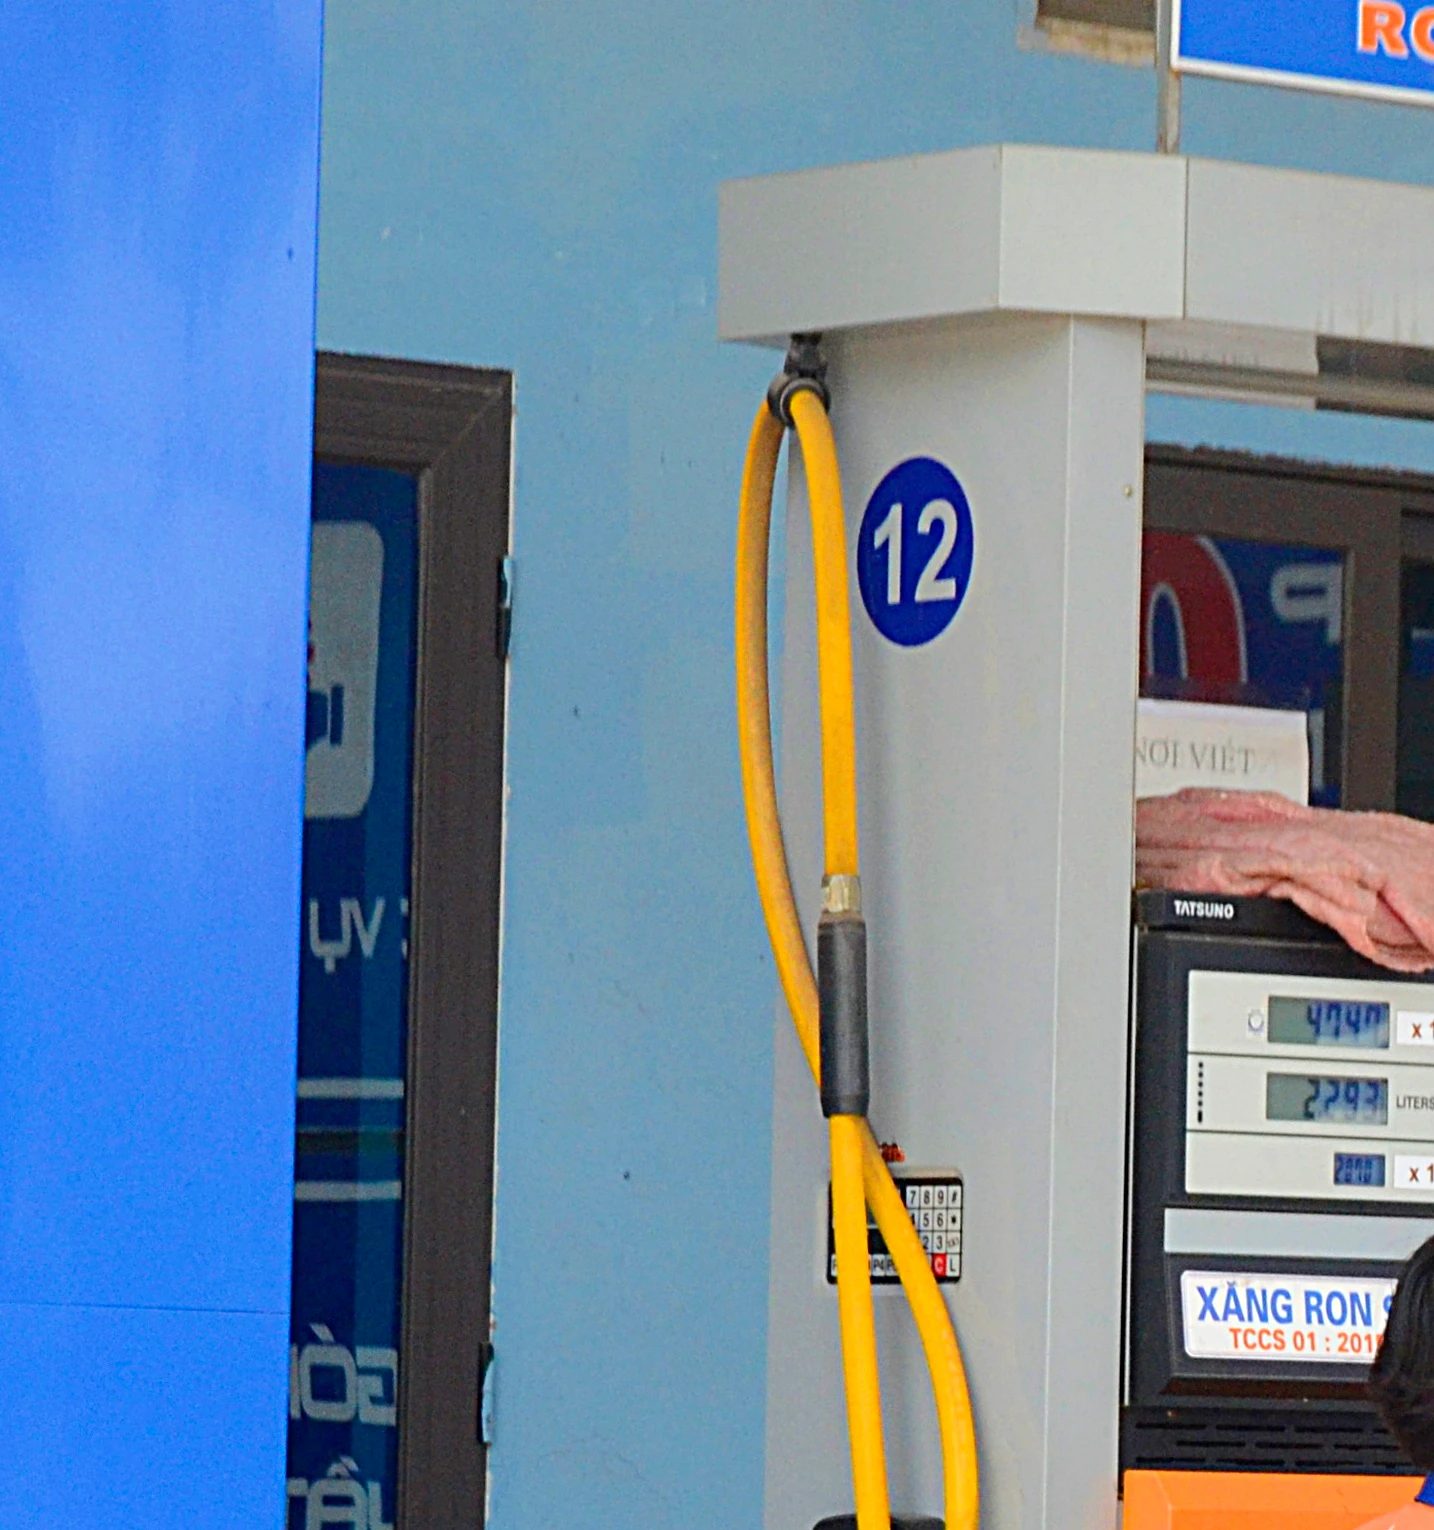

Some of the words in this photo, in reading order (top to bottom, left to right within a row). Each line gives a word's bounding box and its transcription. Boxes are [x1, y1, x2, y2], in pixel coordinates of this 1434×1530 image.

[873, 498, 958, 605] 12
[1174, 899, 1235, 919] TATSUNO
[1411, 1022, 1422, 1039] x
[1409, 1166, 1420, 1183] x
[934, 1257, 943, 1272] C
[1196, 1280, 1294, 1325] XĂNG
[1304, 1289, 1373, 1327] RON
[1229, 1327, 1286, 1351] TCCS
[1293, 1330, 1316, 1352] 01
